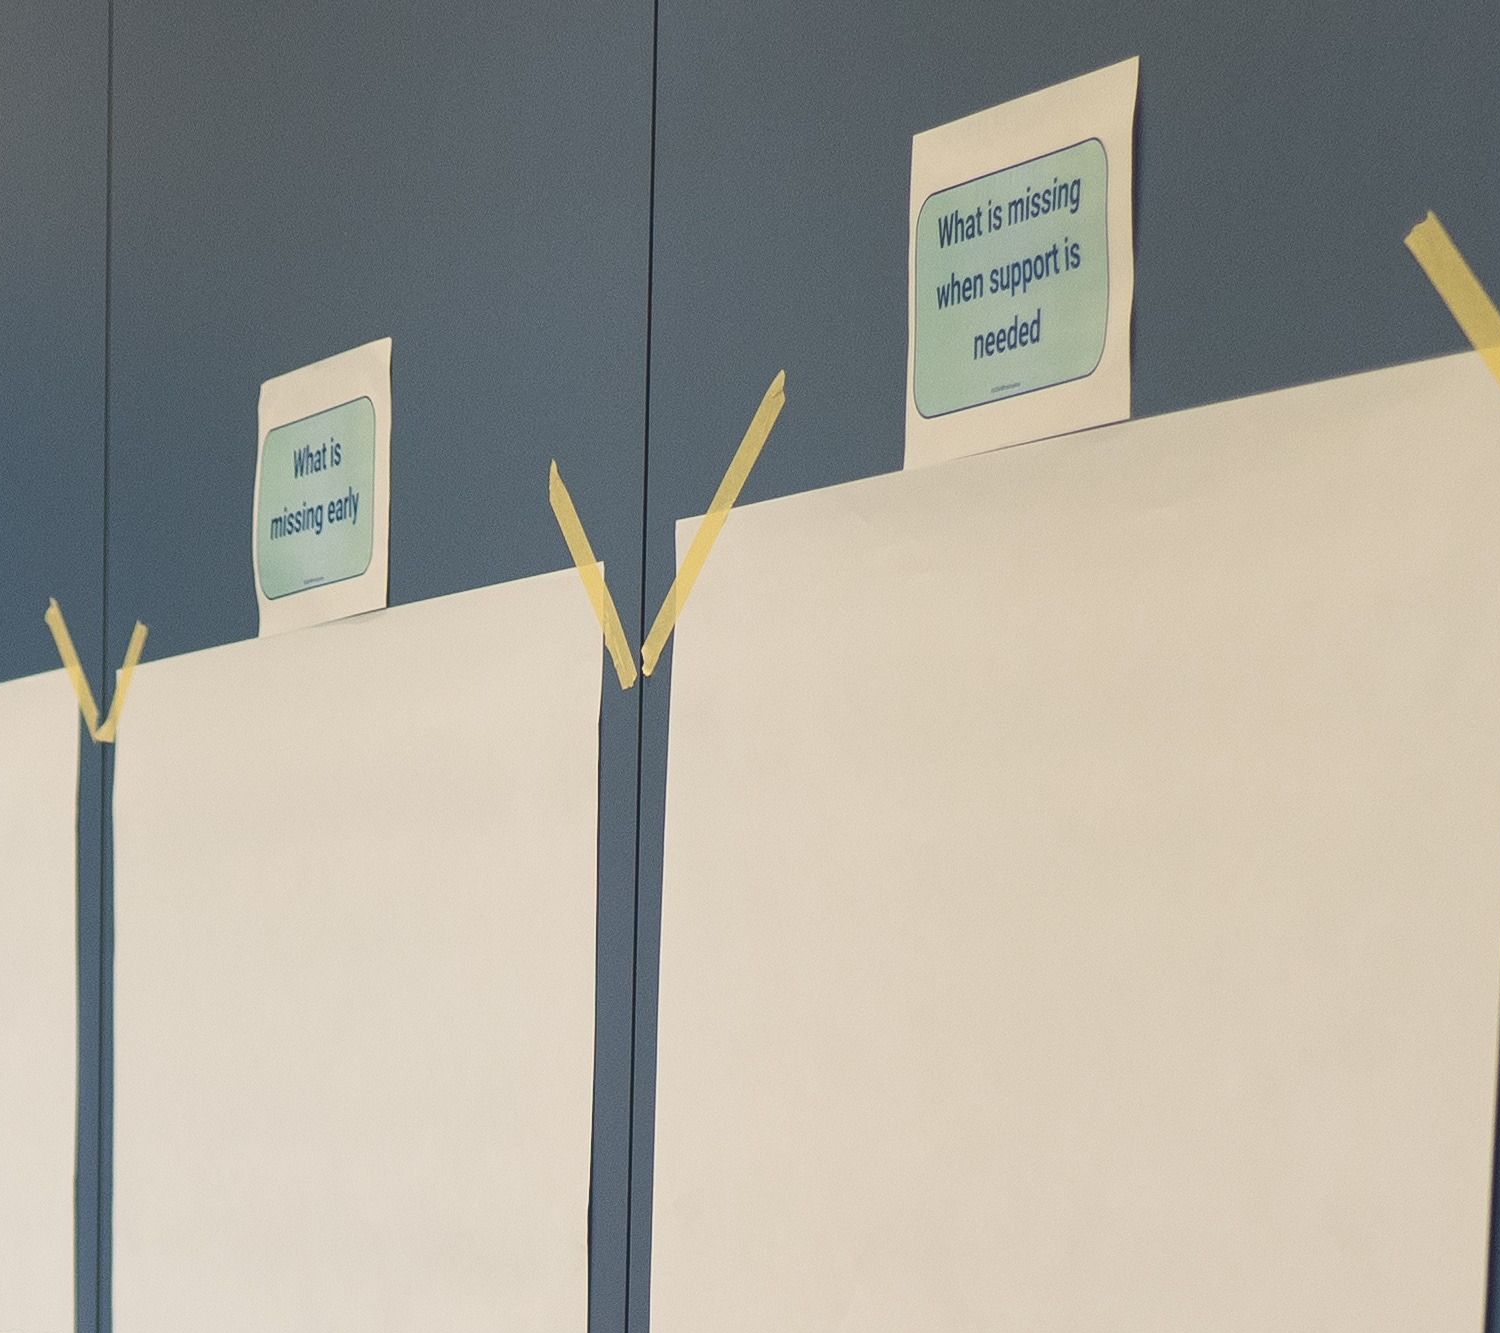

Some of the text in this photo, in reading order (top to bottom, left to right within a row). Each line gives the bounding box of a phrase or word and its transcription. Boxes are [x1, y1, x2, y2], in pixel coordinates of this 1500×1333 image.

[938, 176, 1082, 249] What is missing
[936, 236, 1081, 310] when support is
[973, 308, 1042, 360] needed
[293, 437, 342, 479] What is
[269, 485, 360, 541] missing early
